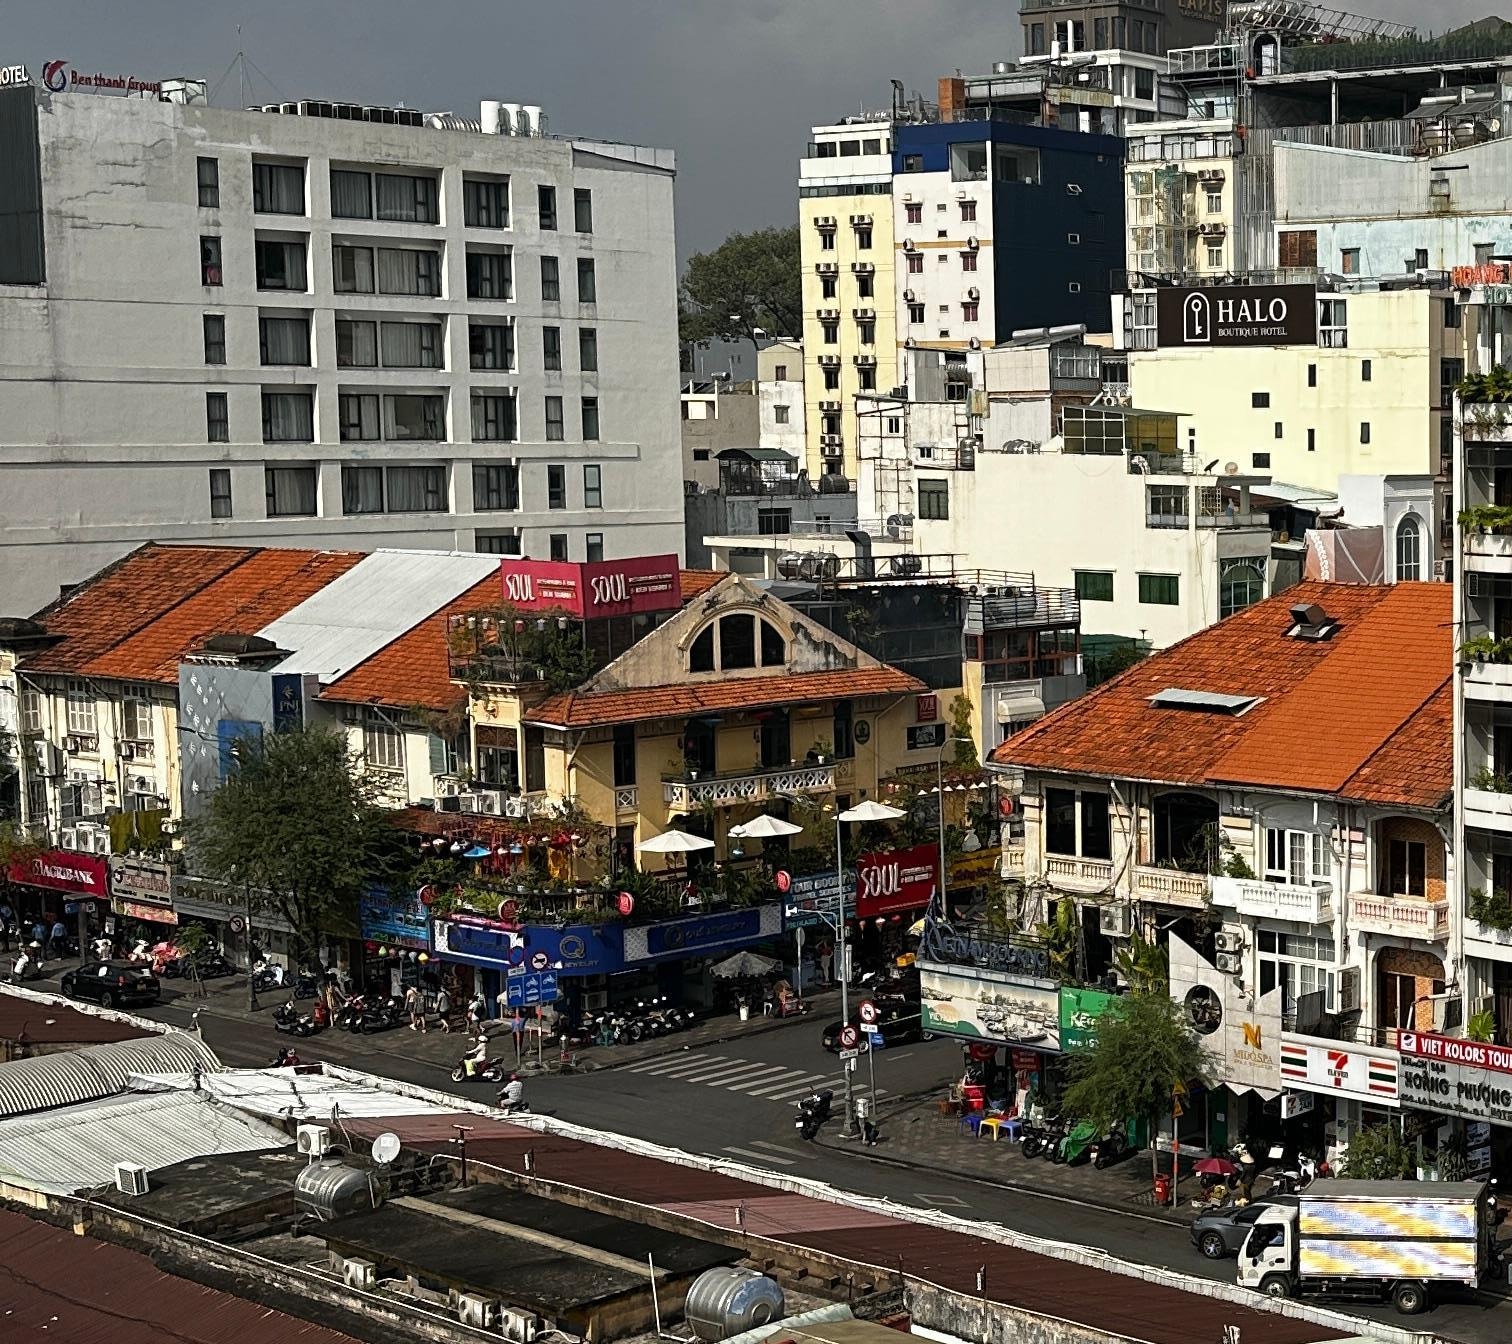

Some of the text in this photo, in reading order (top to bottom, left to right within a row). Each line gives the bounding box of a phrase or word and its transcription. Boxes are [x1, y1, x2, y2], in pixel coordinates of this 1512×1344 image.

[1217, 297, 1287, 323] HALO
[1218, 326, 1288, 338] BOUTIQUE HOTEL
[505, 573, 536, 602] SOUL
[590, 573, 631, 605] SOUL
[860, 862, 902, 899] SOUL
[1420, 1037, 1443, 1055] VIET
[1444, 1042, 1486, 1064] KOLORS
